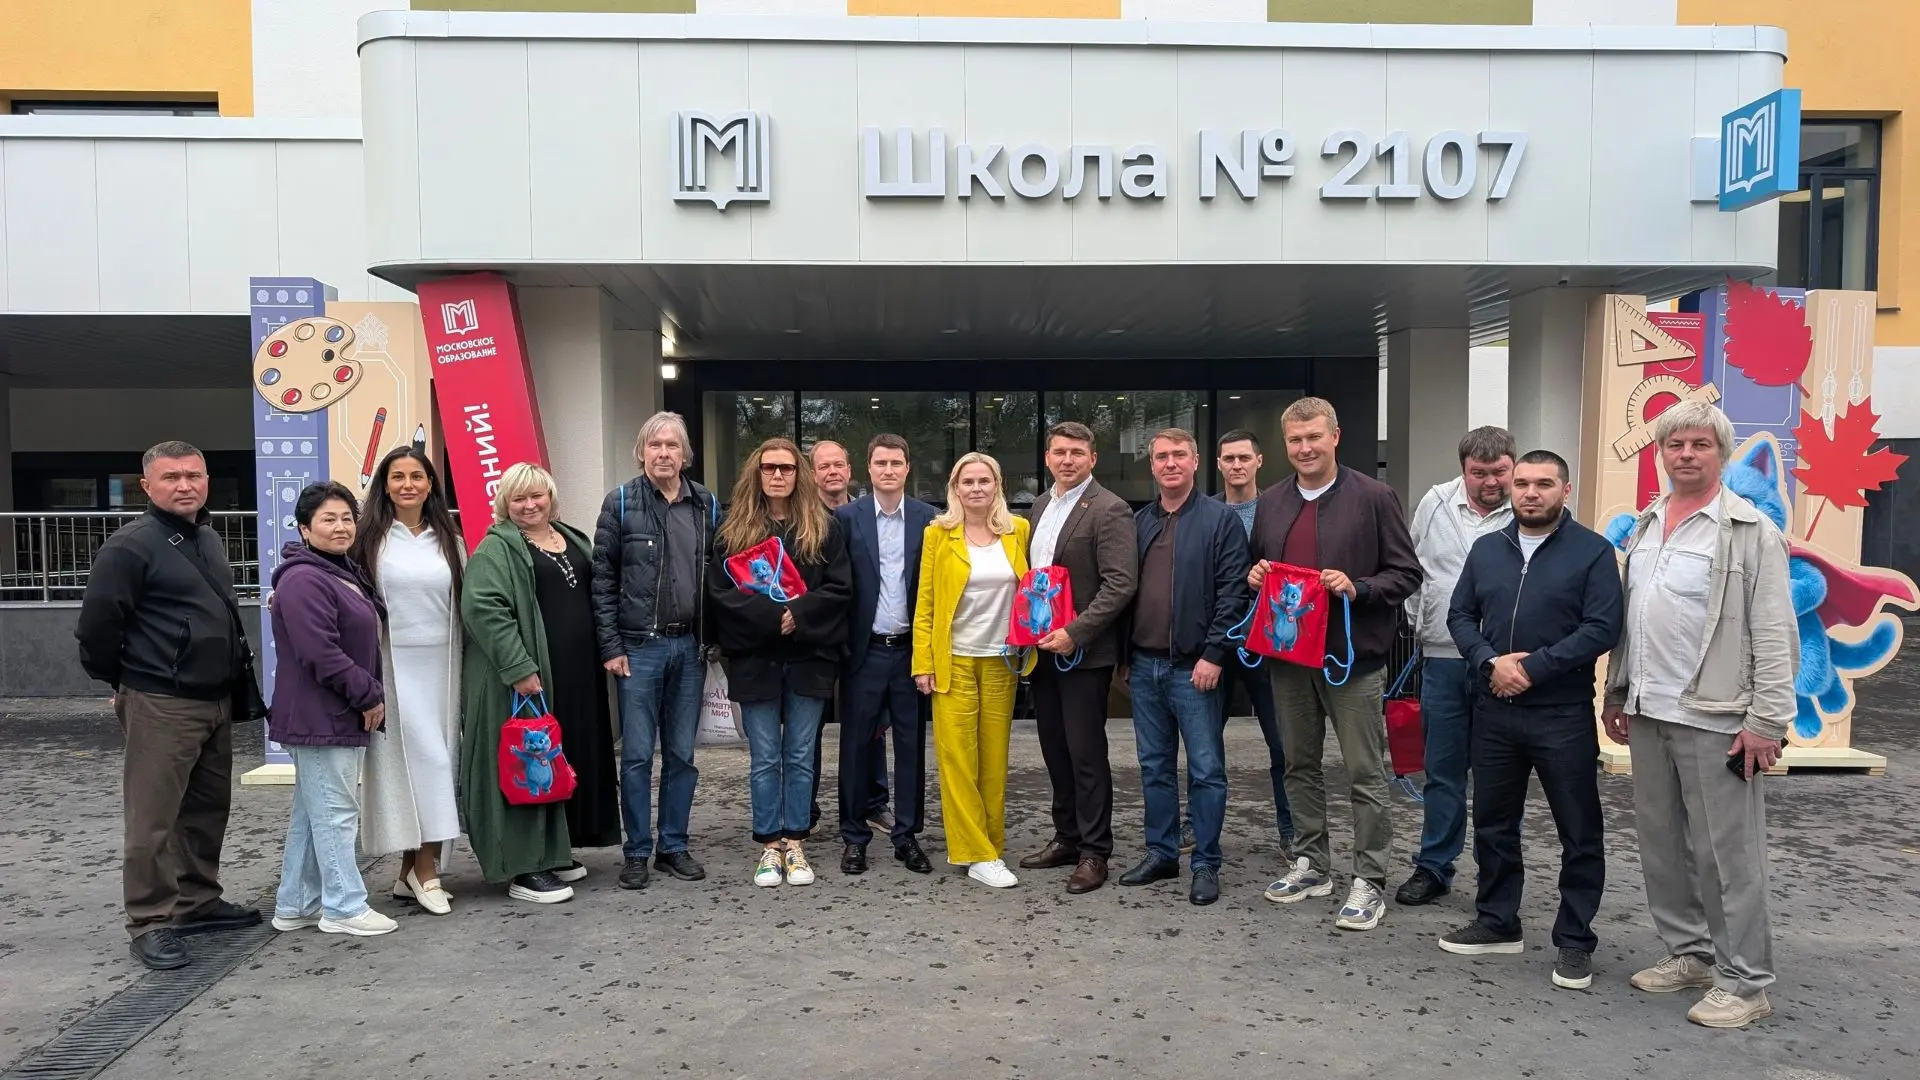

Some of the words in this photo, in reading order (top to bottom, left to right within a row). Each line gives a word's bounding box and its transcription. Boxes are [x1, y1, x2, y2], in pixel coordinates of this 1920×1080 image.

[862, 126, 1168, 200] Школа
[1198, 128, 1295, 201] №
[1320, 129, 1529, 201] 2107
[436, 336, 495, 354] МОСКОВСКОЕ
[438, 347, 497, 364] ОБРАЗОВАНИЕ
[711, 709, 730, 719] мир
